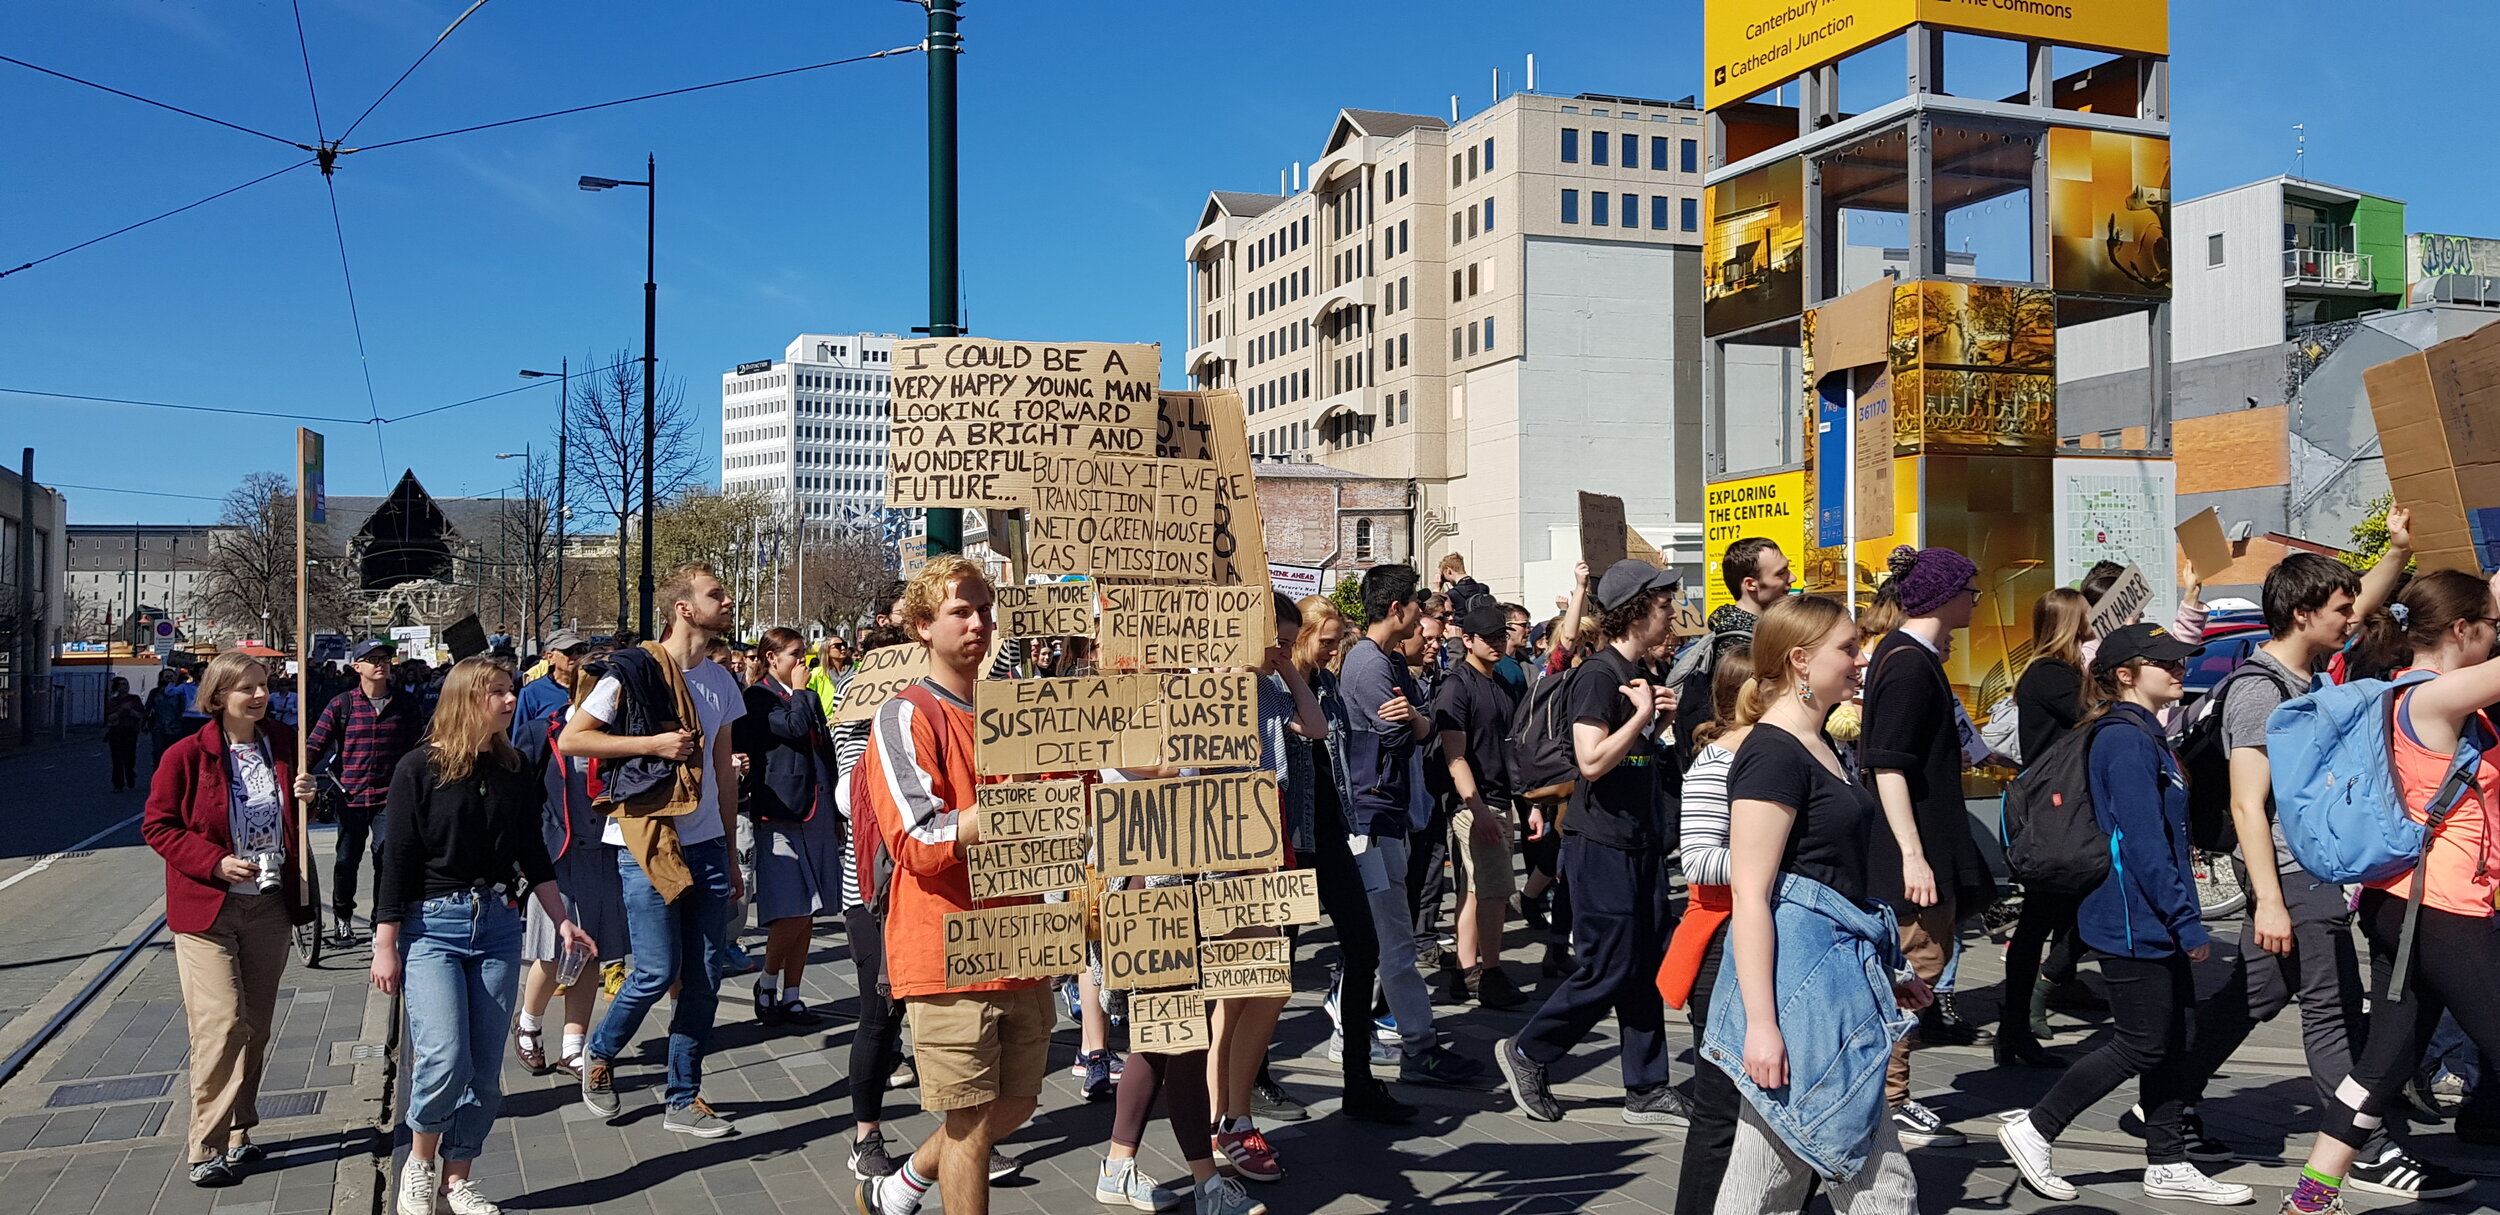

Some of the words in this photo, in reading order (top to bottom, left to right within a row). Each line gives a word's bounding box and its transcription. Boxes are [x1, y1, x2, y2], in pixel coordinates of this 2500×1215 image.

[1745, 0, 1818, 40] Canterbury
[1730, 36, 1792, 79] Cathedral
[1795, 14, 1854, 50] Junction
[901, 343, 938, 370] I
[945, 343, 1032, 371] COULD
[1044, 347, 1088, 372] BE
[1103, 350, 1129, 375] A
[893, 375, 947, 400] VERY
[950, 373, 1018, 399] HAPPY
[1025, 375, 1094, 399] YOUNG
[1105, 379, 1153, 403] MAN
[893, 400, 999, 423] LOOKING
[1013, 399, 1131, 424] FORWARD
[1858, 399, 1887, 422] 361170
[891, 426, 925, 447] TO
[936, 424, 956, 447] A
[967, 421, 1080, 446] BRIGHT
[1088, 427, 1143, 451] AND
[892, 450, 1032, 474] WONDERFUL
[1033, 456, 1076, 485] BUT
[1076, 459, 1138, 487] ONLY
[1142, 463, 1179, 489] IF
[1181, 466, 1216, 491] WE
[893, 474, 1018, 503] FUTURE...
[1032, 487, 1153, 513] TRANSITION
[1161, 495, 1198, 517] TO
[1709, 484, 1776, 506] EXPLORING
[1709, 508, 1731, 523] THE
[1734, 502, 1790, 520] CENTRAL
[1034, 516, 1076, 541] NET
[1100, 516, 1213, 544] GREENHOUSE
[1709, 525, 1741, 541] CITY?
[904, 541, 927, 553] Prote
[1030, 543, 1076, 571] GAS
[909, 561, 924, 570] Fut
[1291, 572, 1315, 580] AHEAD
[997, 586, 1035, 609] RIDE
[1048, 585, 1090, 606] MORE
[1103, 587, 1182, 614] SWITCH
[1185, 590, 1209, 612] TO
[1216, 591, 1262, 613] 100%
[2091, 608, 2115, 640] TRY
[2110, 573, 2149, 625] HARDER
[1113, 613, 1241, 640] RENEWABLE
[1146, 643, 1238, 665] ENERGY
[1017, 679, 1082, 703] EAT
[1088, 680, 1109, 698] A
[1168, 676, 1248, 701] CLOSE
[980, 704, 1160, 745] SUSTAINABLE
[1170, 704, 1249, 728] WASTE
[1036, 739, 1114, 765] DIET
[1168, 734, 1259, 762] STREAMS
[977, 787, 1037, 808] RESTORE
[1045, 785, 1081, 803] OUR
[990, 806, 1081, 836] RIVERS
[1094, 781, 1186, 872] PLANT
[1181, 776, 1279, 868] TREES
[968, 842, 1012, 872] HALT
[1020, 837, 1086, 868] SPECIES
[972, 863, 1087, 898] EXTINCTION
[1200, 878, 1257, 908] PLANT
[1262, 874, 1315, 900] MORE
[1104, 890, 1188, 918] CLEAN
[1220, 902, 1292, 928] TREES
[948, 913, 1031, 944] DIVEST
[1032, 911, 1083, 936] FROM
[1106, 920, 1144, 947] UP
[1151, 917, 1189, 940] THE
[946, 951, 1009, 978] FOSSIL
[1018, 944, 1082, 968] FUELS
[1111, 947, 1194, 978] OCEAN
[1202, 942, 1248, 965] STOP
[1252, 939, 1289, 963] OIL
[1203, 966, 1292, 989] EXPLORATION
[1133, 995, 1169, 1023] FIX
[1172, 994, 1202, 1018] THE
